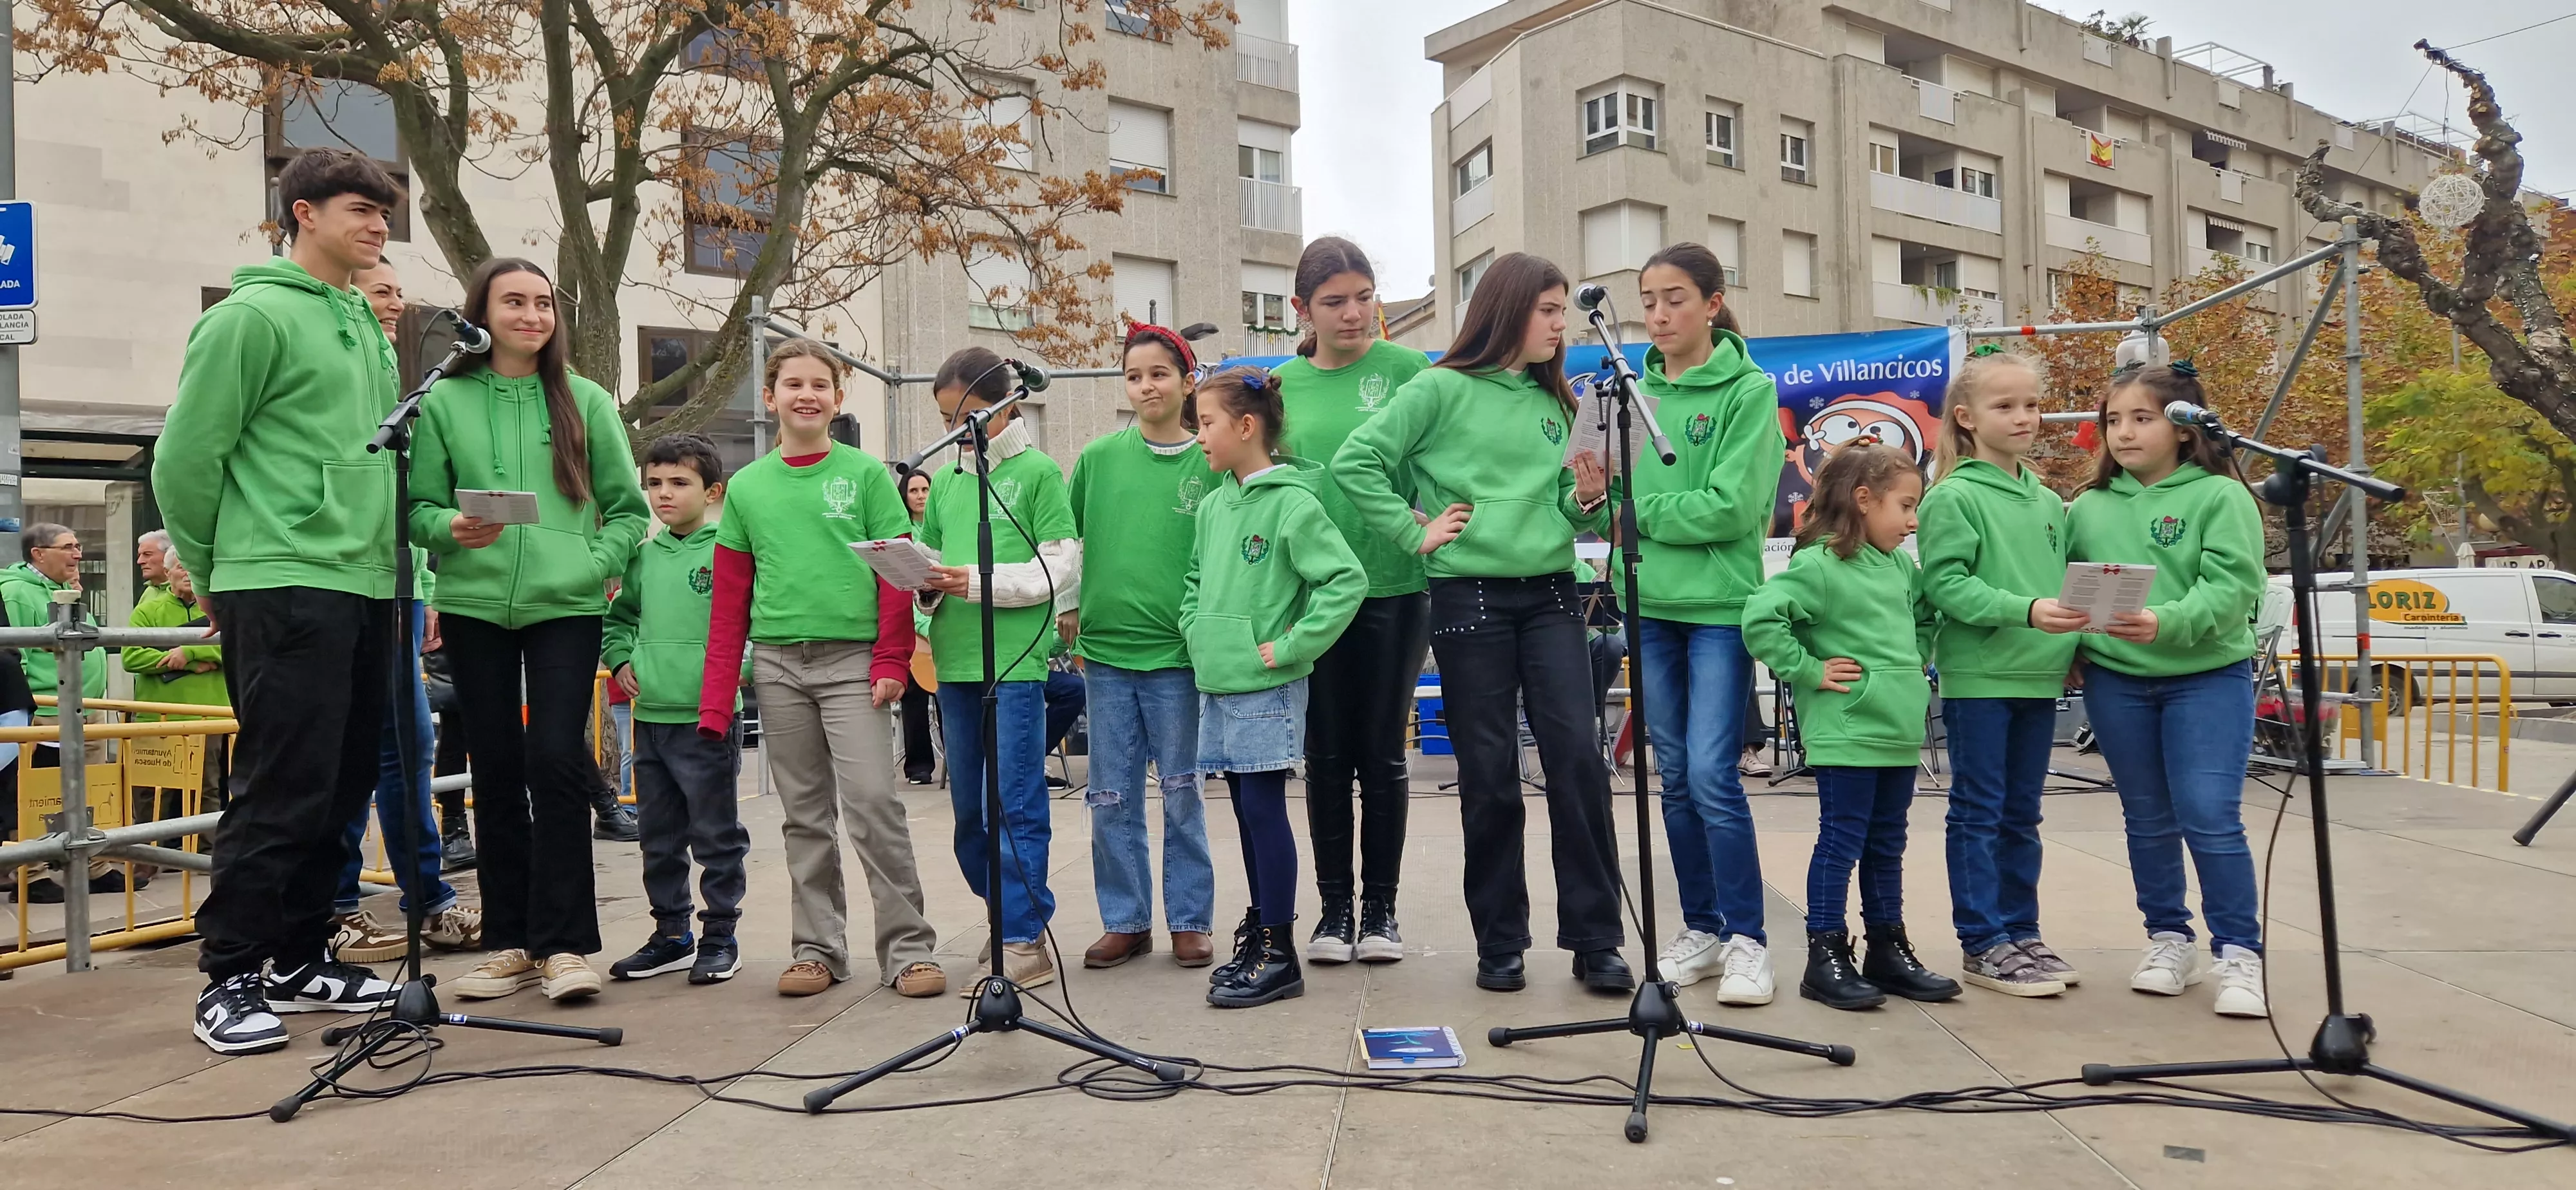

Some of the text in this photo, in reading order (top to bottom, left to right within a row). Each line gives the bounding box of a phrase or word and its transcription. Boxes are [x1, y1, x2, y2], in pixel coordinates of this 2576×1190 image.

[1784, 363, 1814, 385] de
[1818, 355, 1942, 382] Villancicos
[1765, 542, 1794, 552] ación
